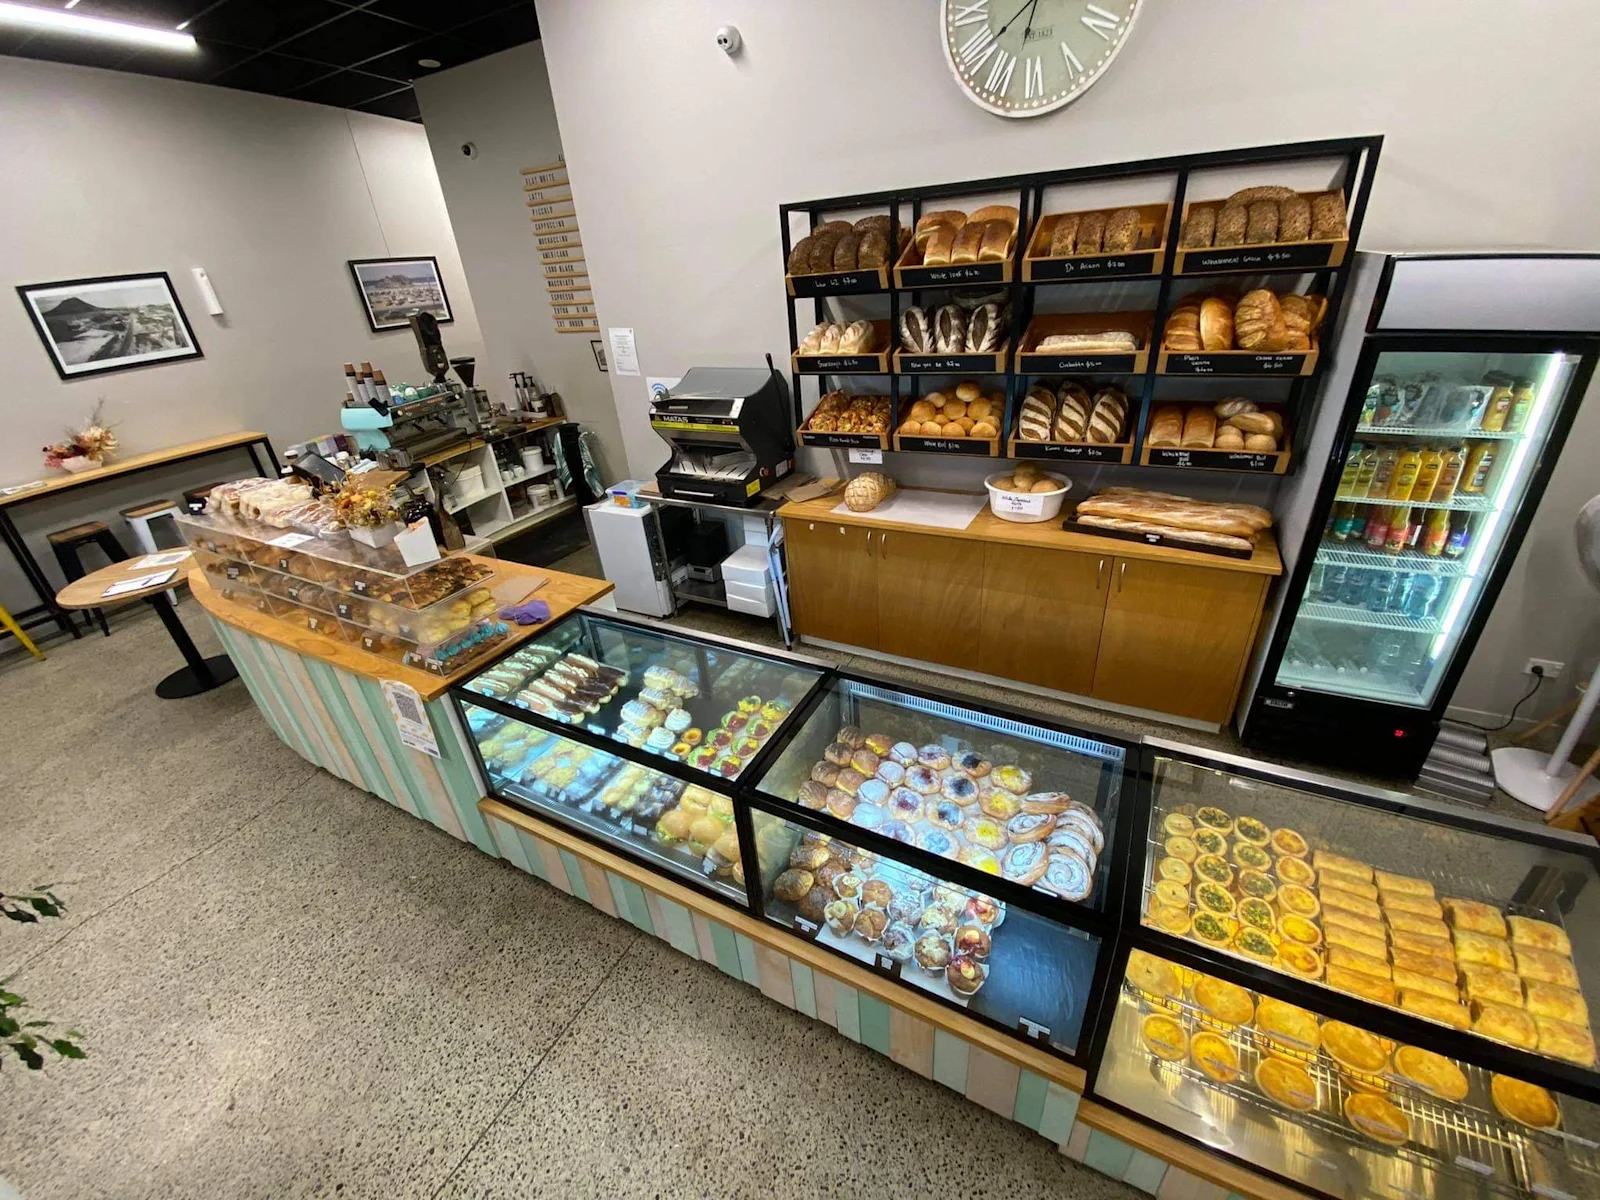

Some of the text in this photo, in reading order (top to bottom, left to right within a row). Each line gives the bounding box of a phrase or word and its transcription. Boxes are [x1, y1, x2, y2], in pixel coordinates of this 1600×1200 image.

[528, 191, 544, 201] LATTE
[532, 206, 554, 216] PICCOLO
[535, 220, 565, 231] CAPPUCCINO
[542, 250, 569, 259] AMERICANO
[545, 264, 575, 273] LONG BLACK
[548, 279, 575, 288] MACCHIATO
[551, 293, 575, 301] ESPRESSO
